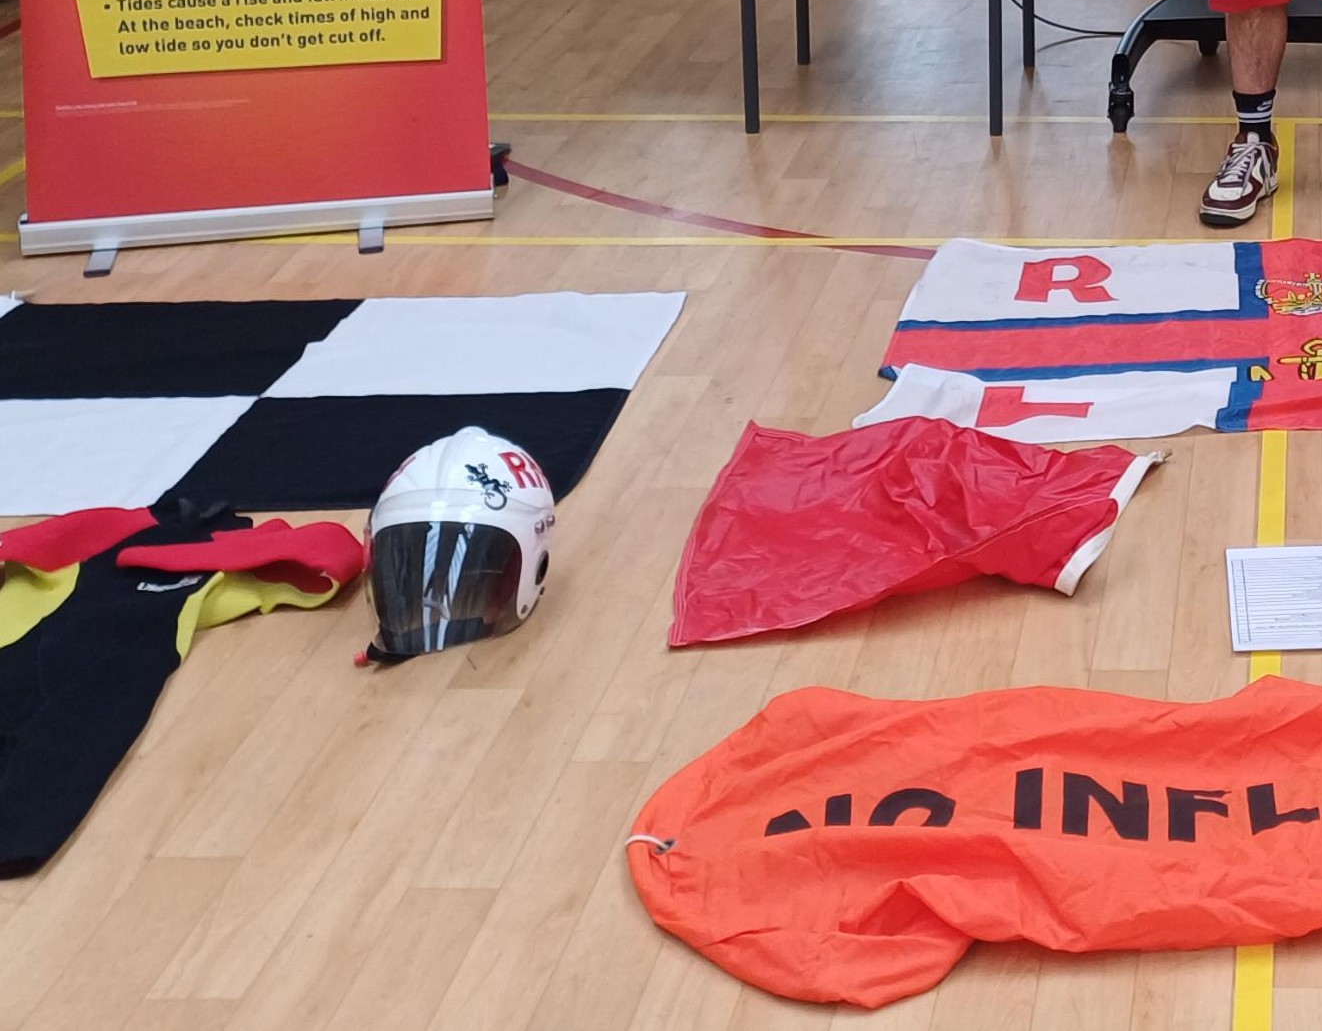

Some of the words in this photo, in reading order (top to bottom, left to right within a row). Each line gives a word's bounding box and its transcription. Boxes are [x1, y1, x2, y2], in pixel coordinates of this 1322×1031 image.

[117, 19, 136, 33] At
[142, 17, 169, 31] the
[174, 14, 229, 30] beach,
[235, 12, 283, 27] check
[288, 11, 334, 25] times
[339, 8, 355, 21] of
[360, 7, 395, 23] high
[400, 6, 429, 19] and
[1015, 257, 1117, 302] R
